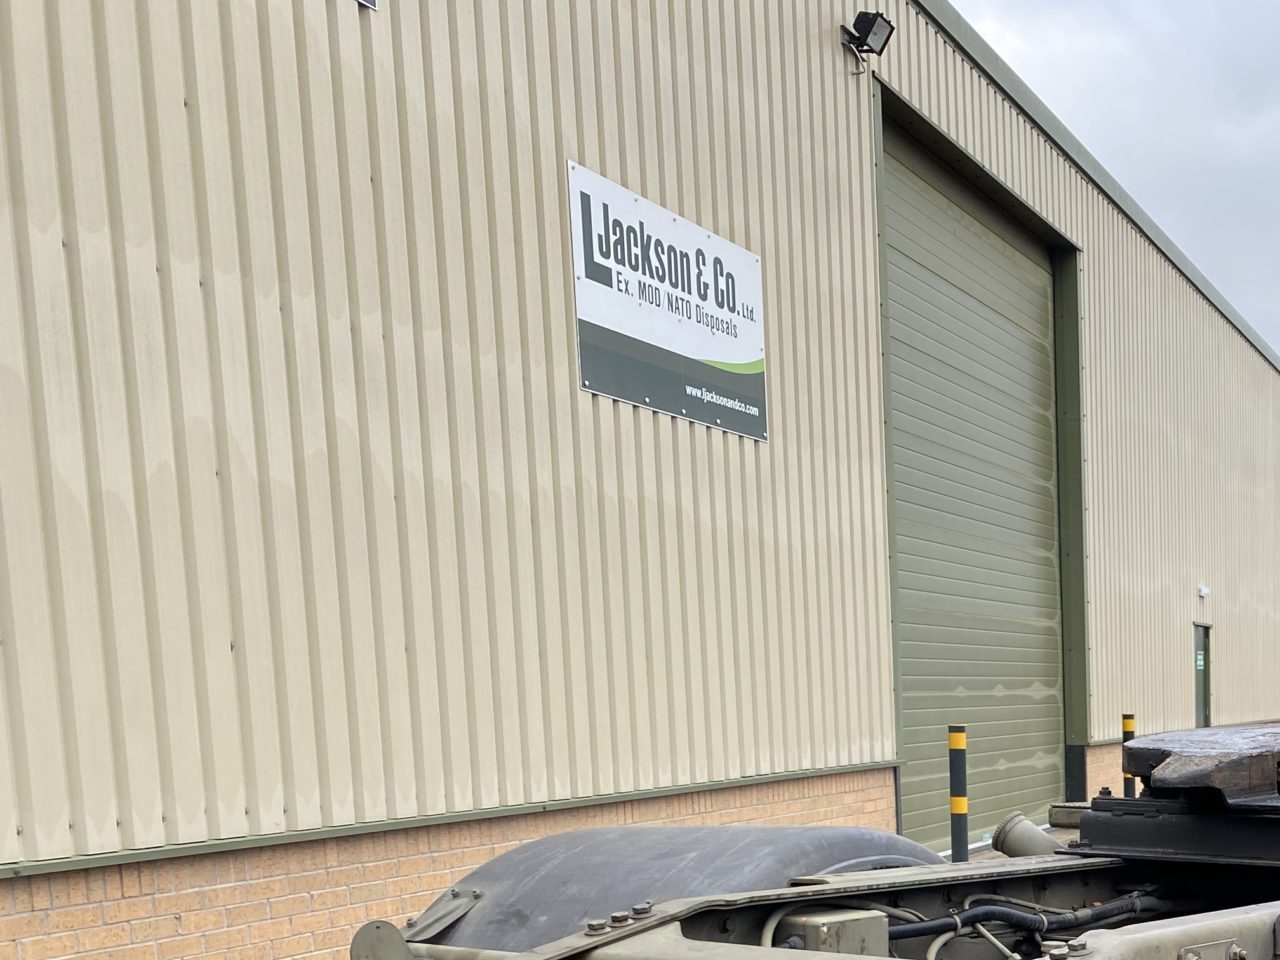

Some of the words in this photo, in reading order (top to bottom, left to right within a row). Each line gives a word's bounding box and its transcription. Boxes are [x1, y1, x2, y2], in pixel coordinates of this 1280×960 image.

[695, 247, 709, 302] &
[742, 303, 756, 323] Ltd.
[695, 304, 738, 338] Disposals
[685, 384, 759, 417] www.ljacksonandco.com
